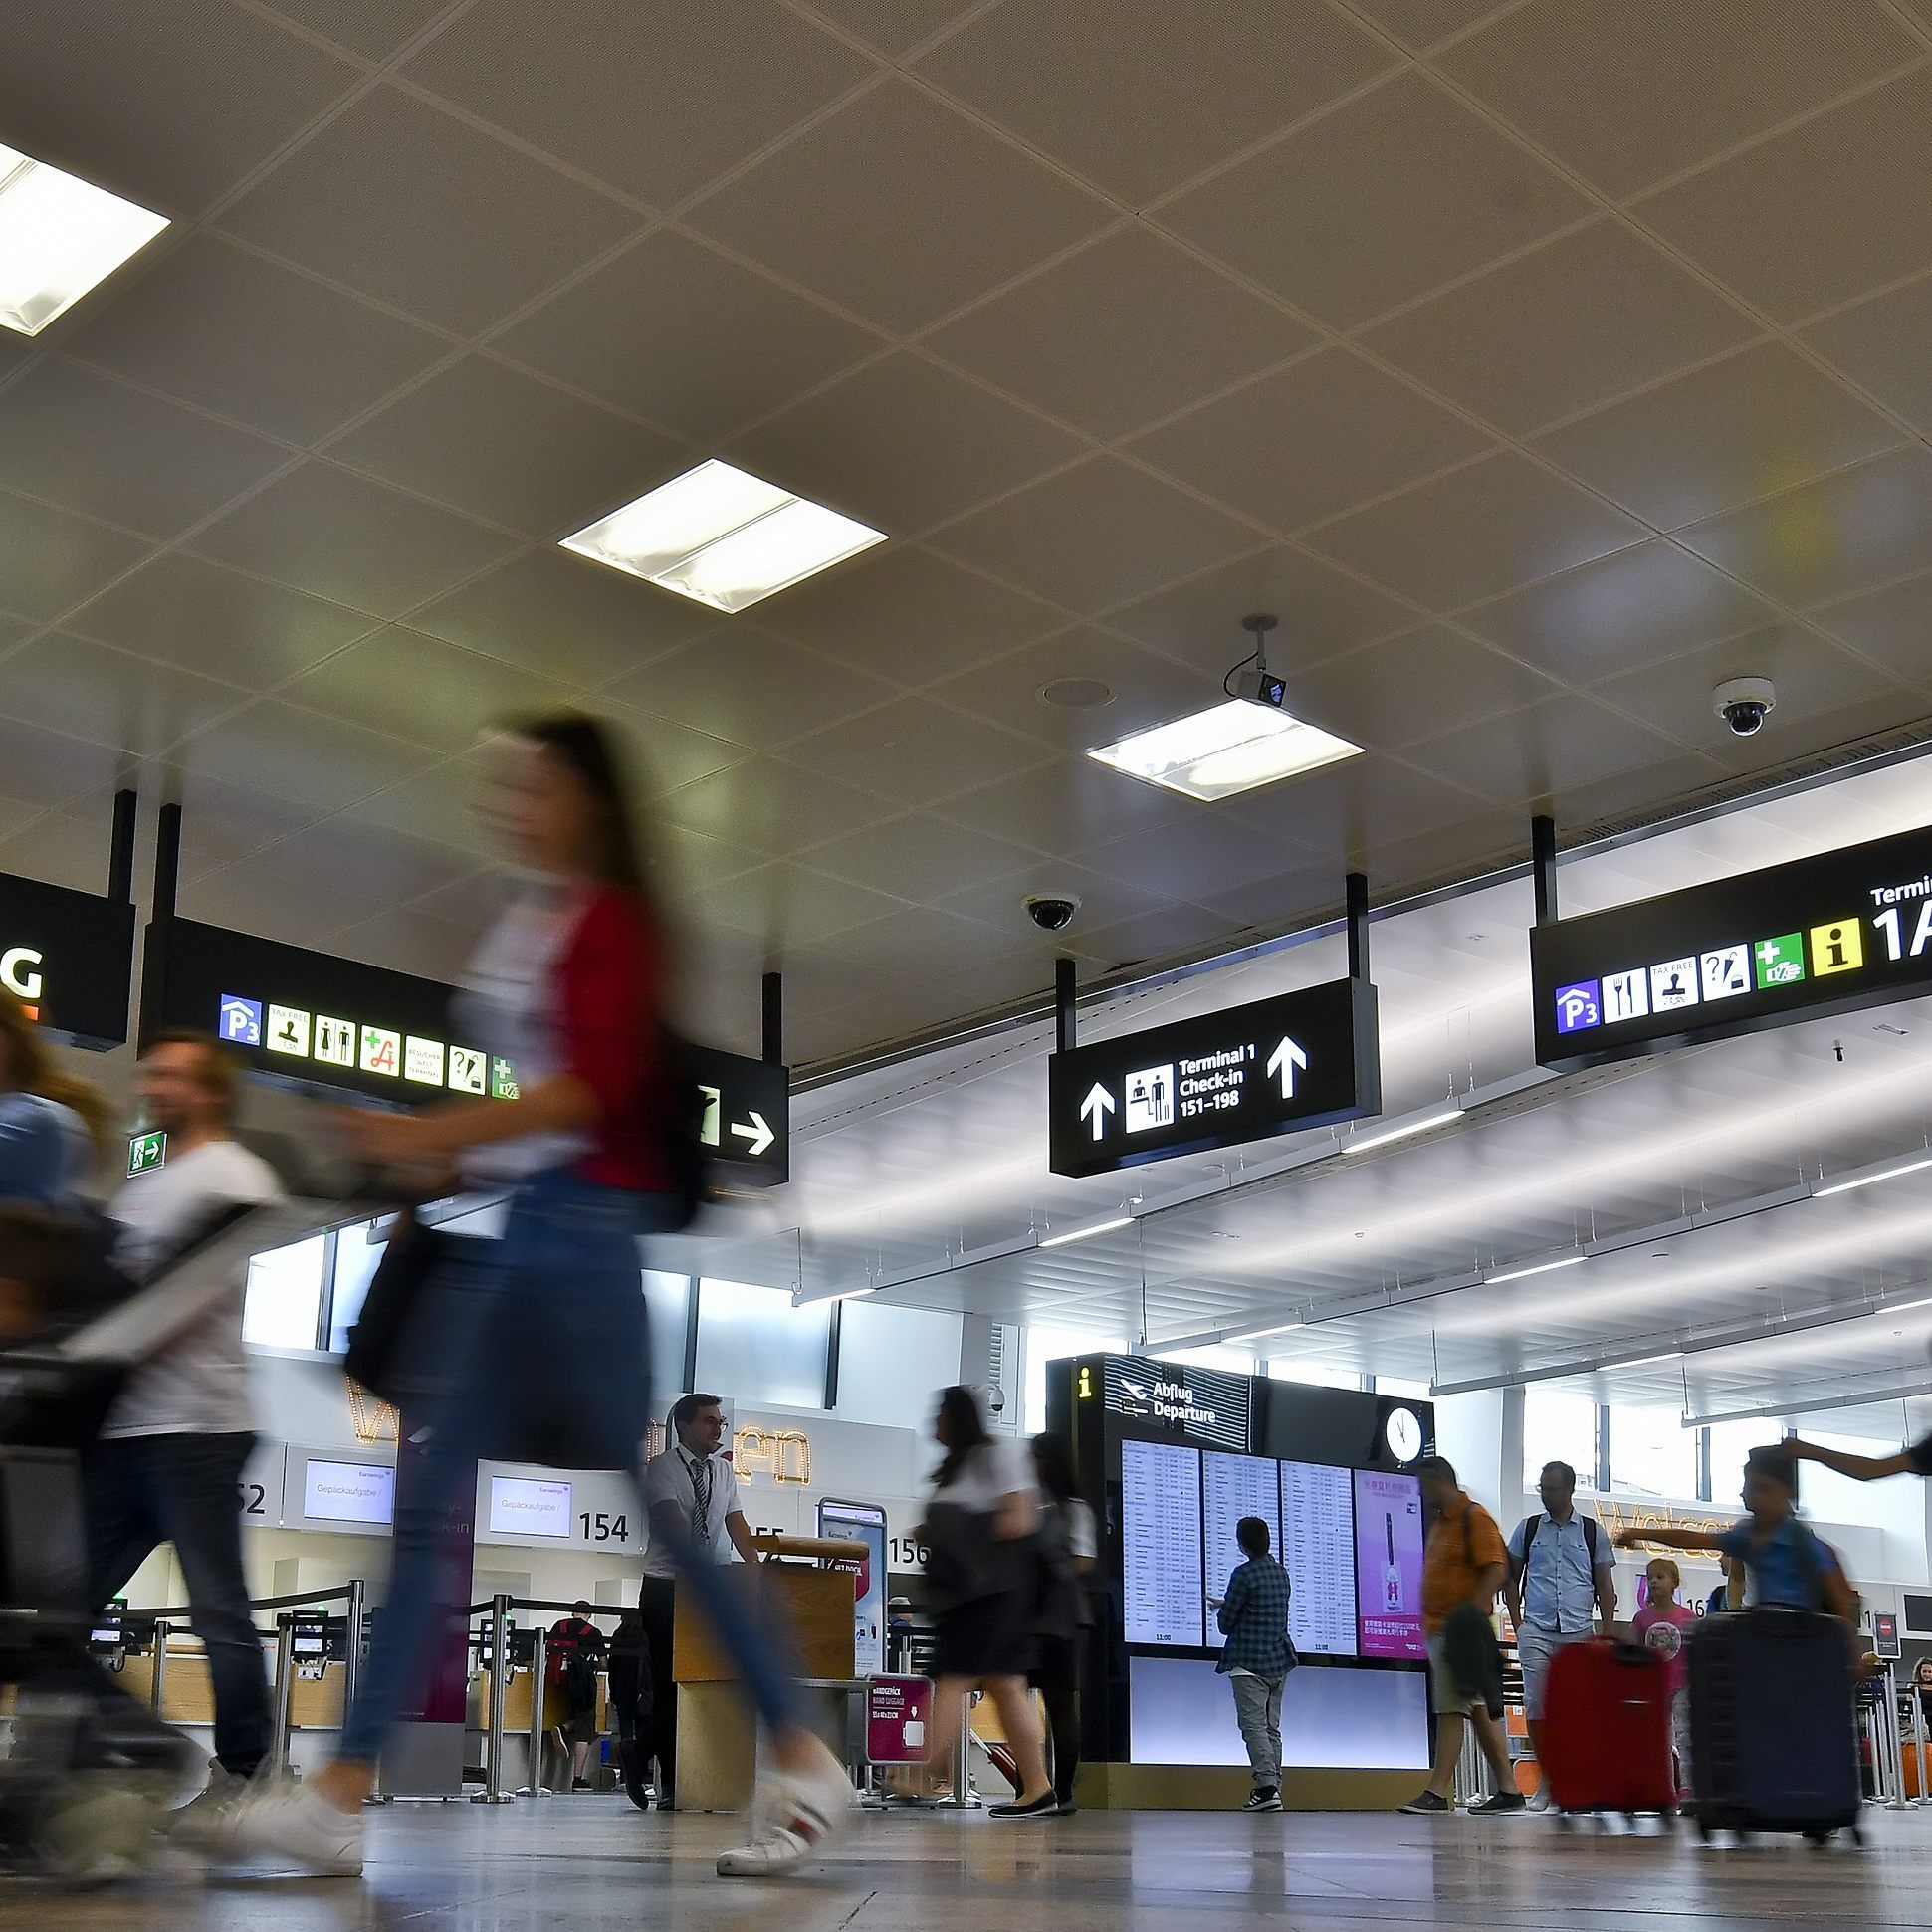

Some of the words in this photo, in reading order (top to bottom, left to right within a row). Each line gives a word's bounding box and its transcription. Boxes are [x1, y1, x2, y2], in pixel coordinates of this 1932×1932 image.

[1870, 875, 1932, 906] Termi
[0, 947, 43, 999] G
[1652, 966, 1669, 976] TAX
[1671, 961, 1693, 972] FREE
[271, 1007, 288, 1018] TAX
[288, 1011, 308, 1023] FREE
[1178, 1045, 1244, 1076] Terminal
[1247, 1043, 1255, 1060] 1
[1179, 1068, 1244, 1097] Check-in
[1153, 1382, 1193, 1404] Abflug
[1154, 1400, 1216, 1423] Departure
[579, 1511, 629, 1543] 154
[889, 1537, 931, 1565] 156
[1686, 1598, 1711, 1618] 16
